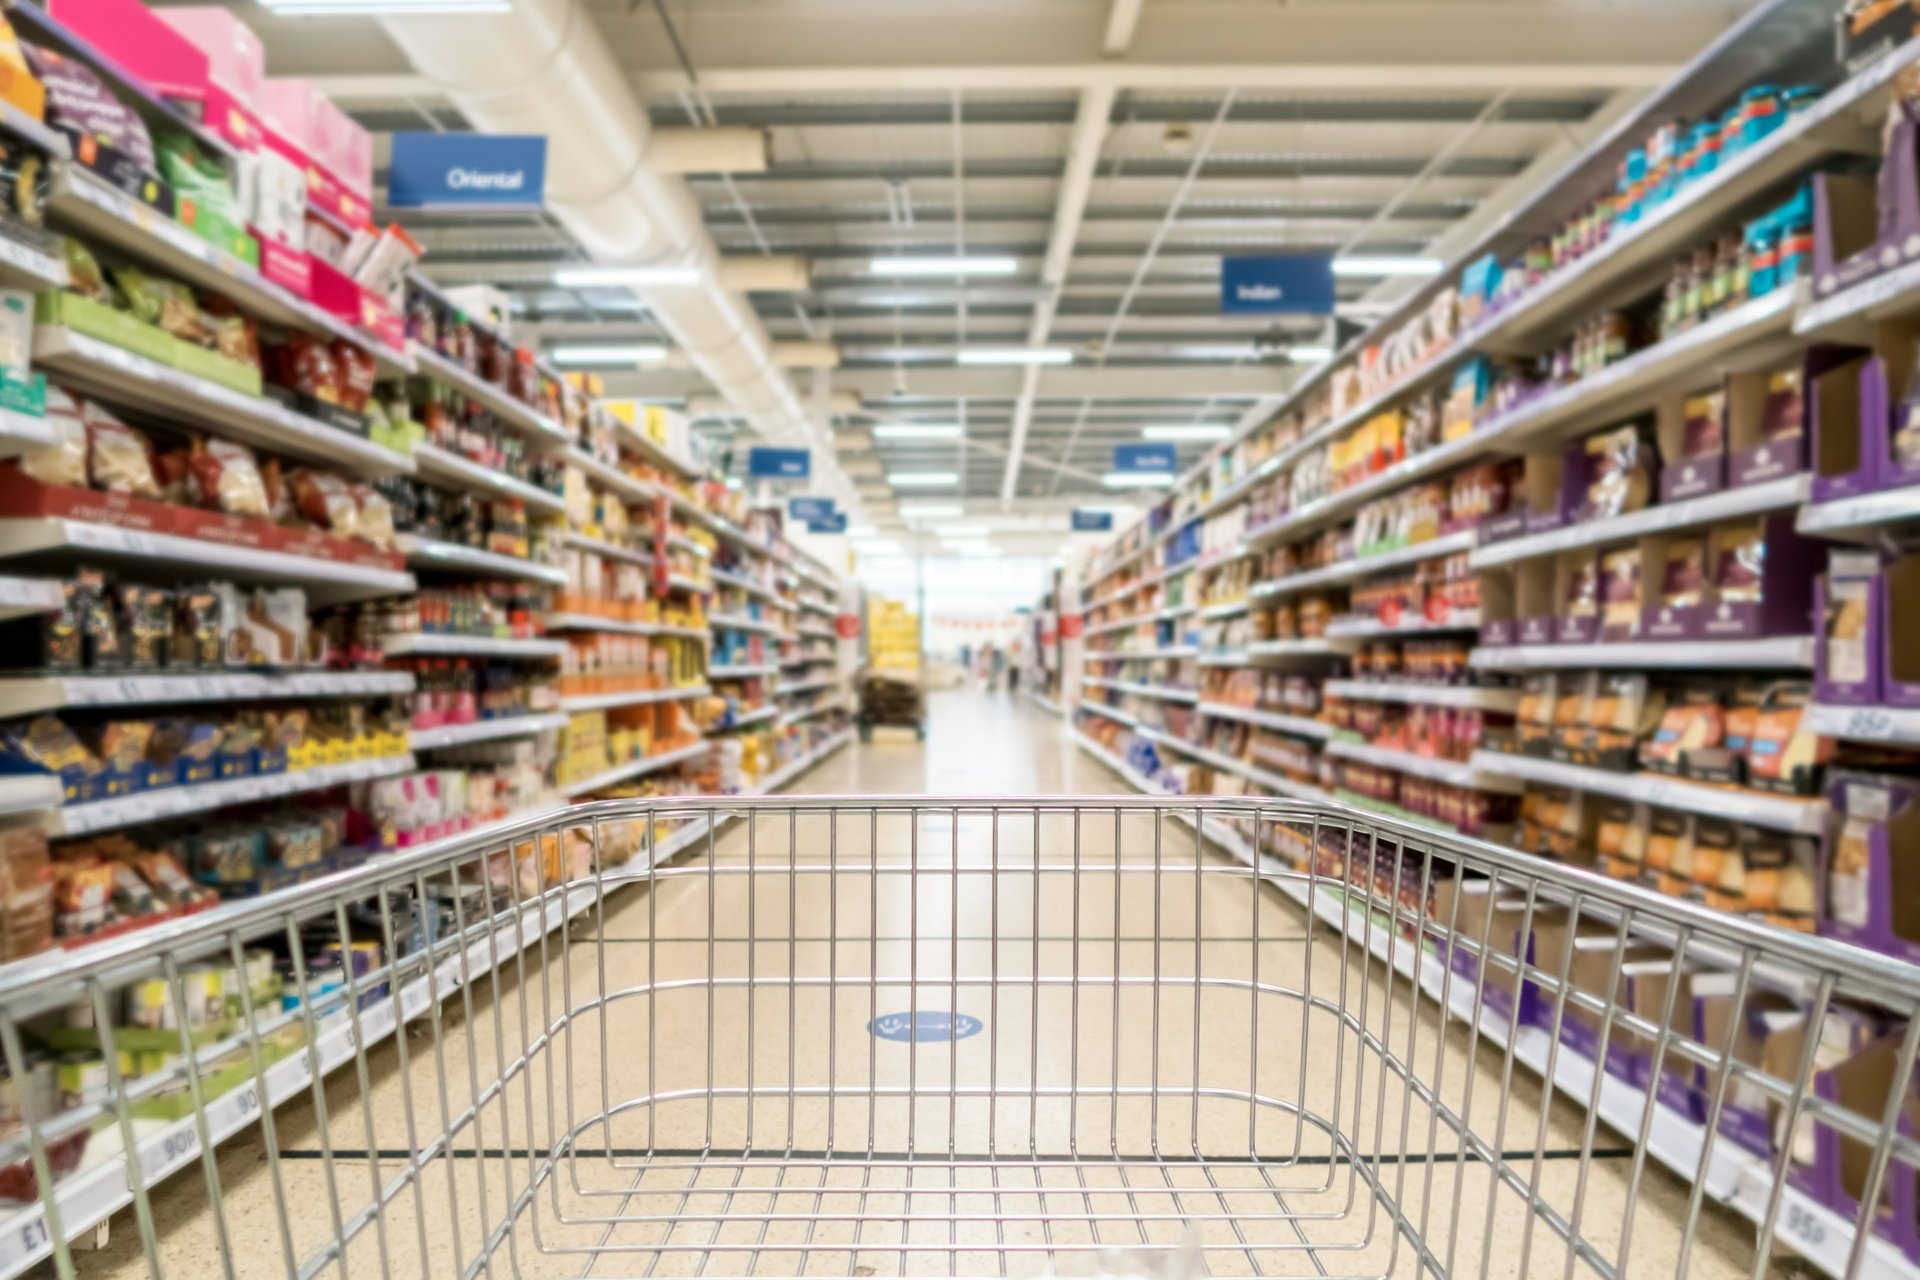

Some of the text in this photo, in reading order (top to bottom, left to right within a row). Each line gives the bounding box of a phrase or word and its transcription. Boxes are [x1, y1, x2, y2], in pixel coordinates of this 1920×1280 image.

[447, 168, 524, 190] Oriental
[163, 1128, 196, 1161] 90p
[22, 1217, 48, 1252] £1
